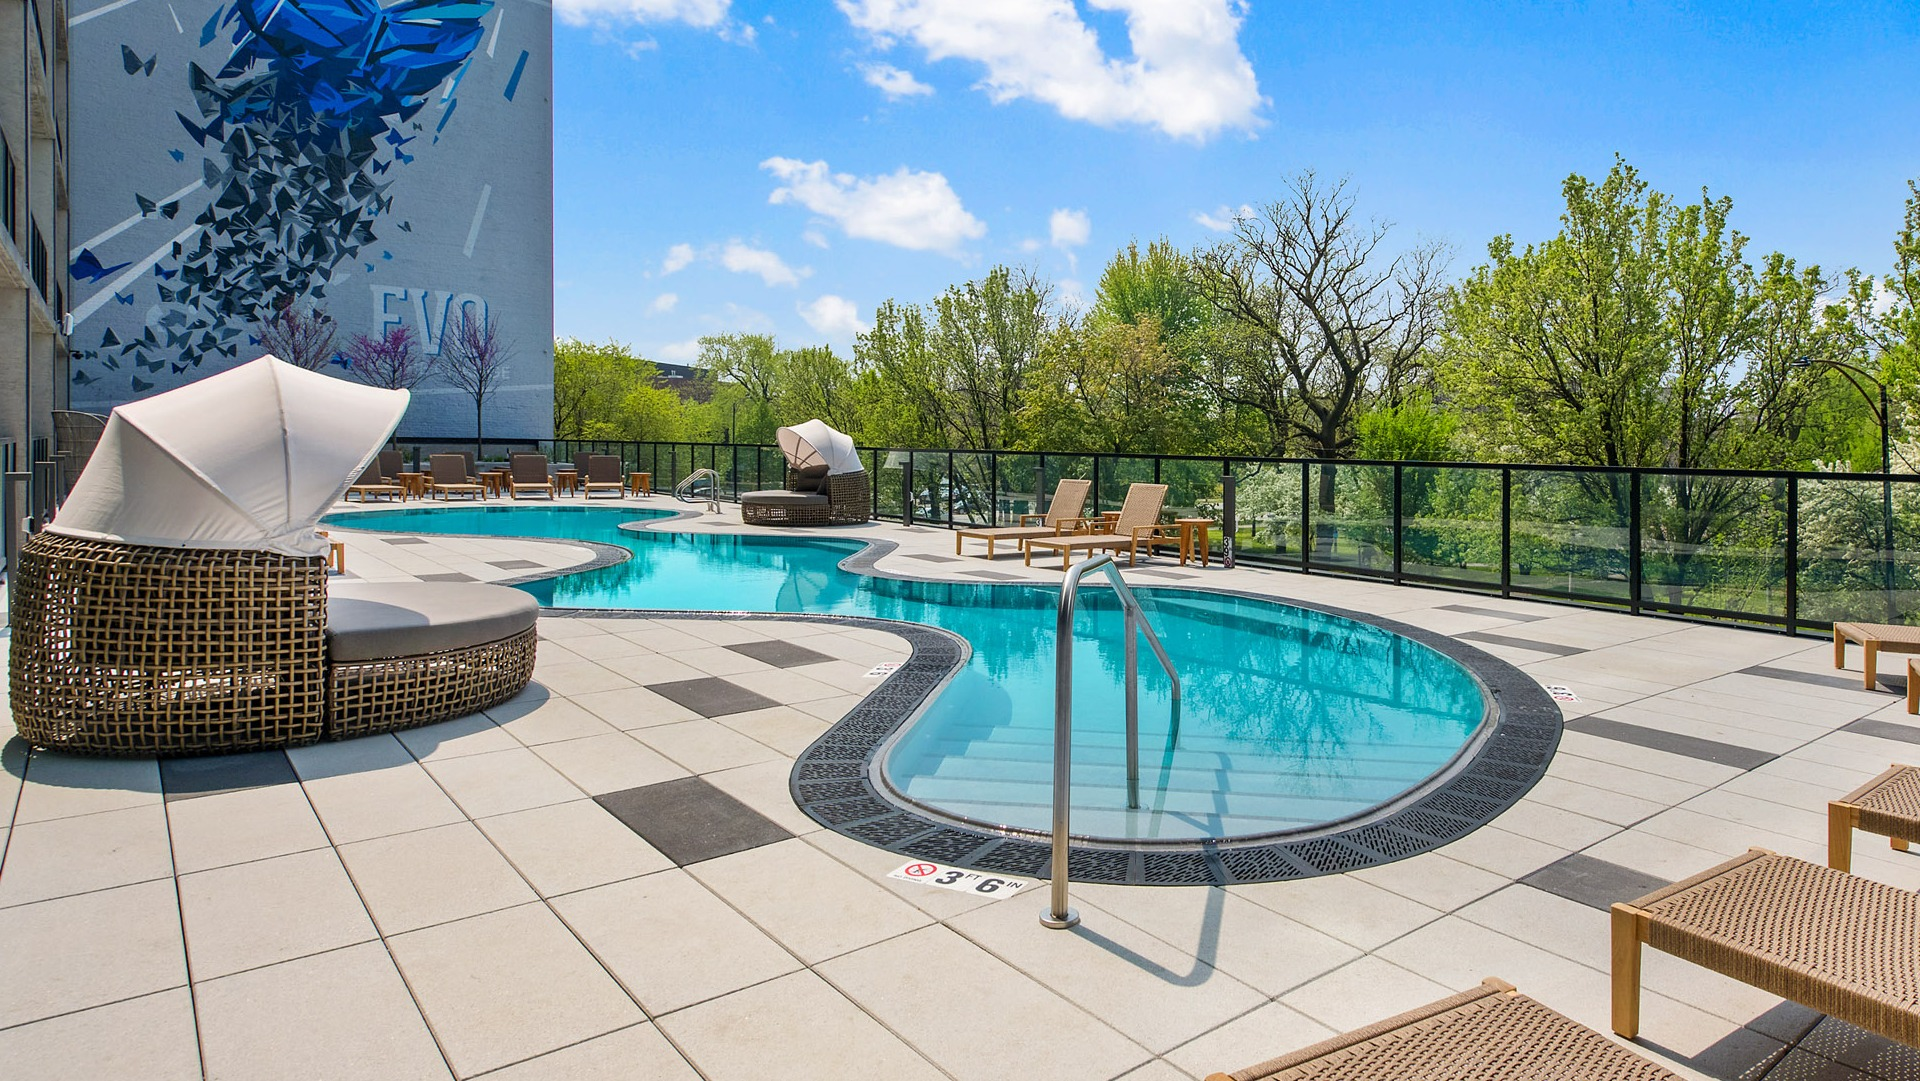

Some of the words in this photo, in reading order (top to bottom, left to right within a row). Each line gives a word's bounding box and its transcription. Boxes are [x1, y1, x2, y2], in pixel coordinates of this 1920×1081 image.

[369, 284, 489, 356] EVO
[935, 870, 965, 885] 3
[965, 873, 983, 881] FT
[975, 877, 1006, 894] 6
[1006, 881, 1023, 889] IN
